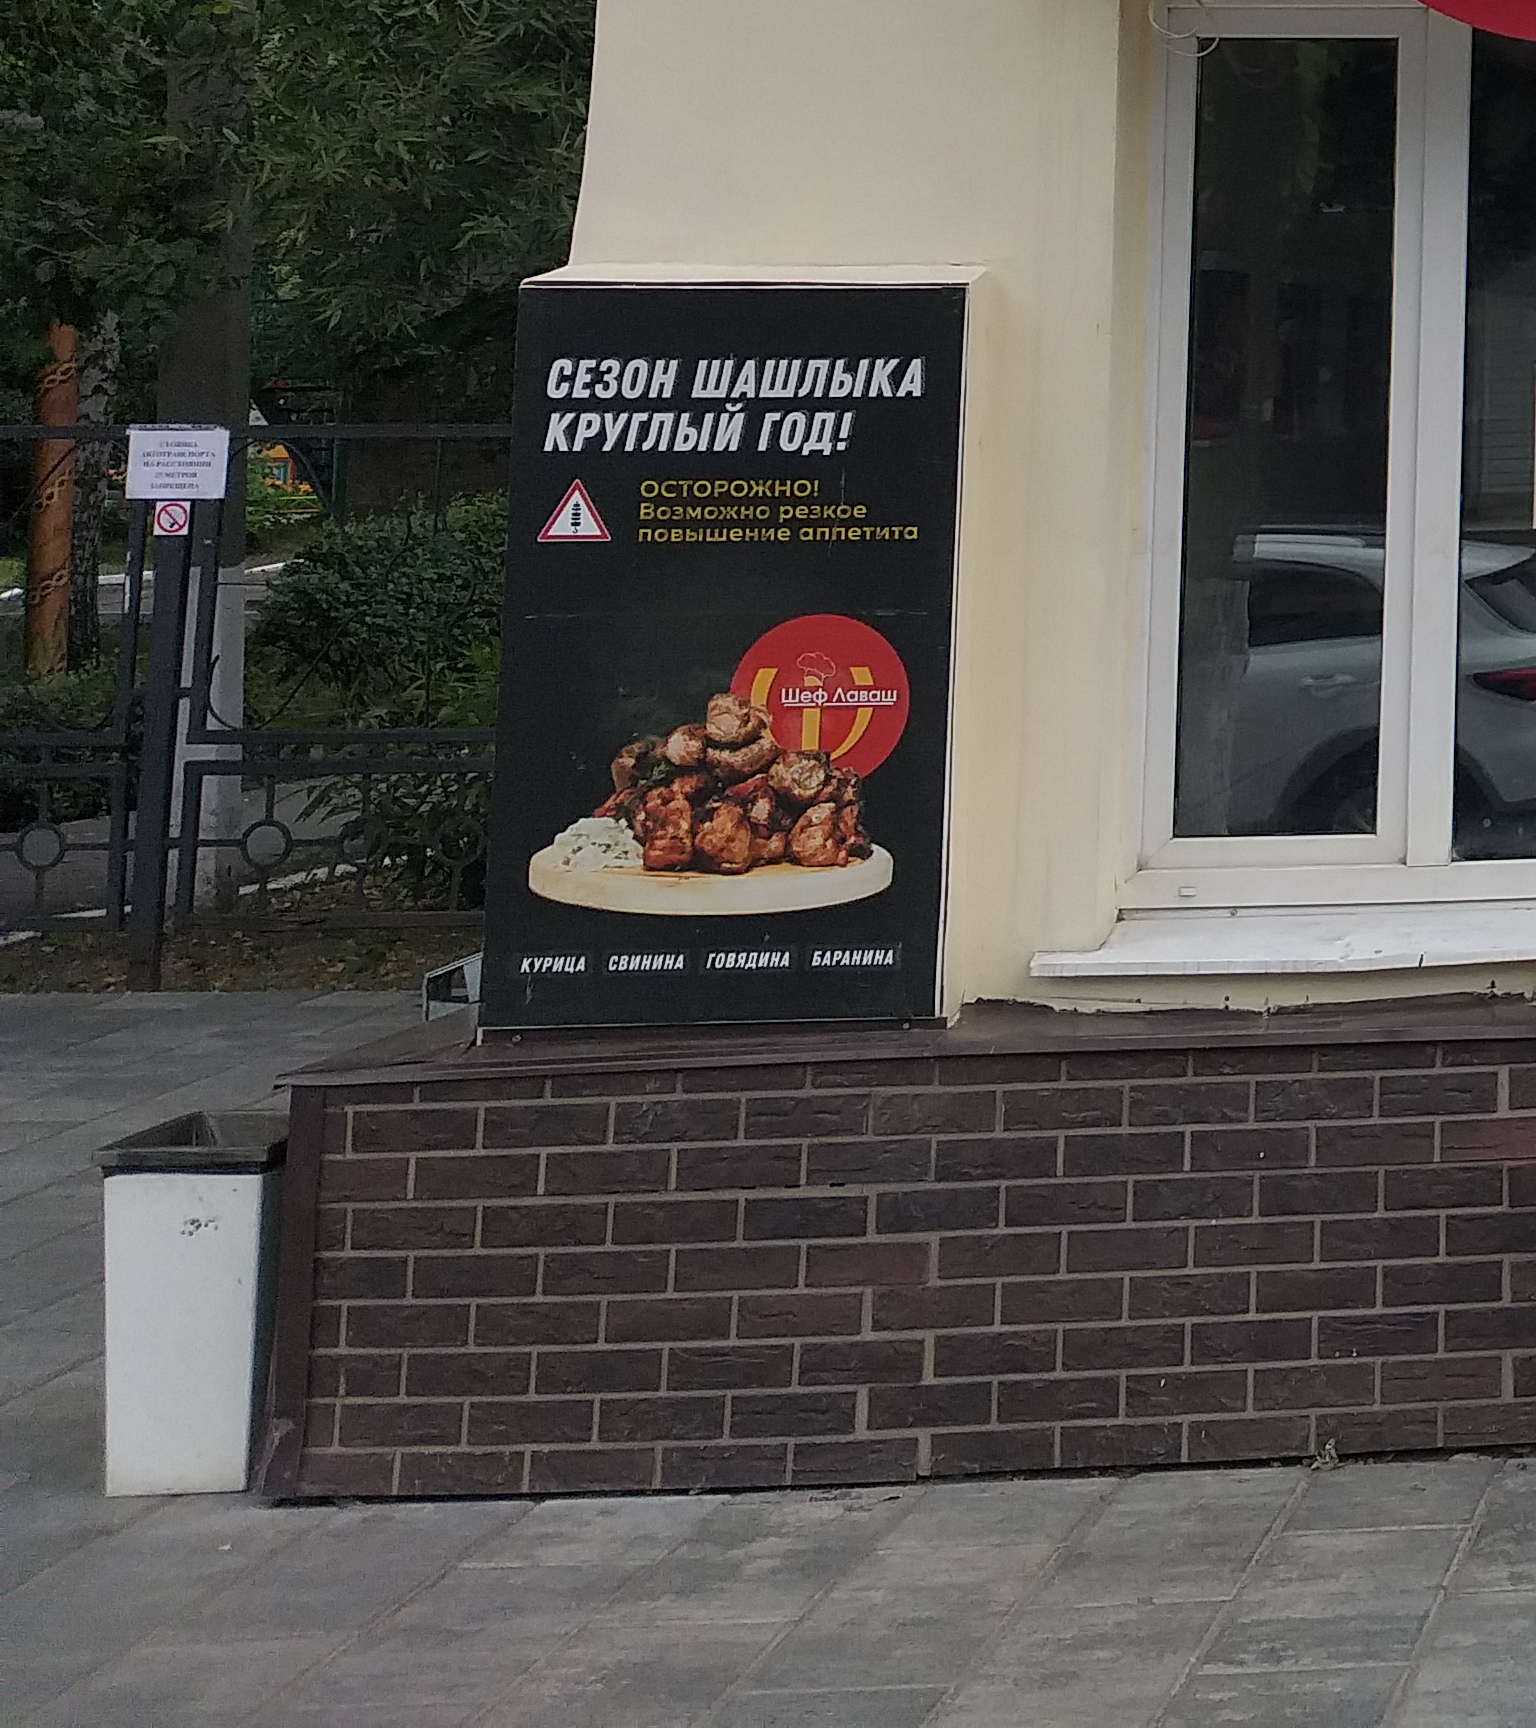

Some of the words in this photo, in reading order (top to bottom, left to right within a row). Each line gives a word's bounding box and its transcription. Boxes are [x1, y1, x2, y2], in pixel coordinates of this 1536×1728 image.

[546, 358, 680, 399] СЕЗОН
[691, 358, 926, 399] ШАШЛЫКА
[543, 402, 747, 452] КРУГЛЫЙ
[757, 410, 854, 456] ГОД!
[639, 479, 820, 499] ОСТОРОЖНО!
[639, 502, 771, 521] Возможно
[779, 503, 868, 523] резкое
[637, 526, 792, 543] повышение
[799, 524, 920, 542] аппетита
[781, 687, 828, 707] Шеф
[832, 687, 898, 703] Лаваш
[520, 955, 587, 974] КУРИЦА
[608, 953, 685, 972] СВИНИНА
[706, 951, 791, 970] ГОВЯДИНА
[811, 949, 895, 968] БАРАНИНА
